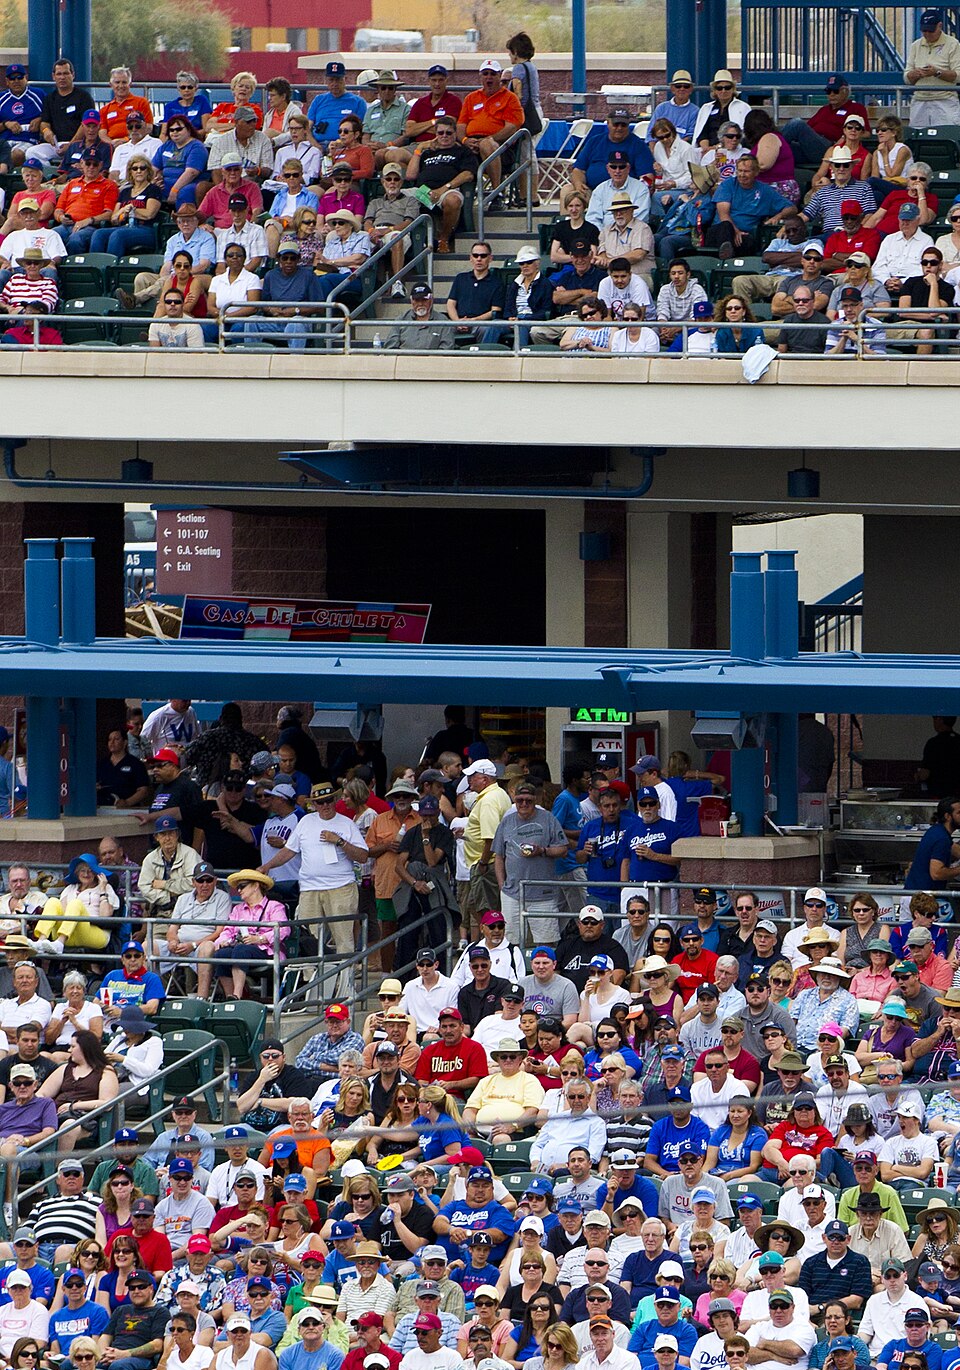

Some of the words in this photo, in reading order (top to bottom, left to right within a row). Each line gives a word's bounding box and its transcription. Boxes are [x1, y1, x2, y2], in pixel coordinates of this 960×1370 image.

[177, 513, 206, 524] Sections
[177, 529, 209, 540] 101-107
[177, 546, 193, 556] G.A.
[194, 546, 221, 558] Seating
[126, 554, 140, 565] A5
[177, 562, 191, 572] Exit
[575, 708, 628, 722] ATM
[631, 832, 667, 848] Dodgers
[769, 908, 785, 917] TIME
[525, 995, 554, 1006] CHICAGO
[452, 1210, 489, 1224] Dodgers
[480, 1233, 487, 1243] X
